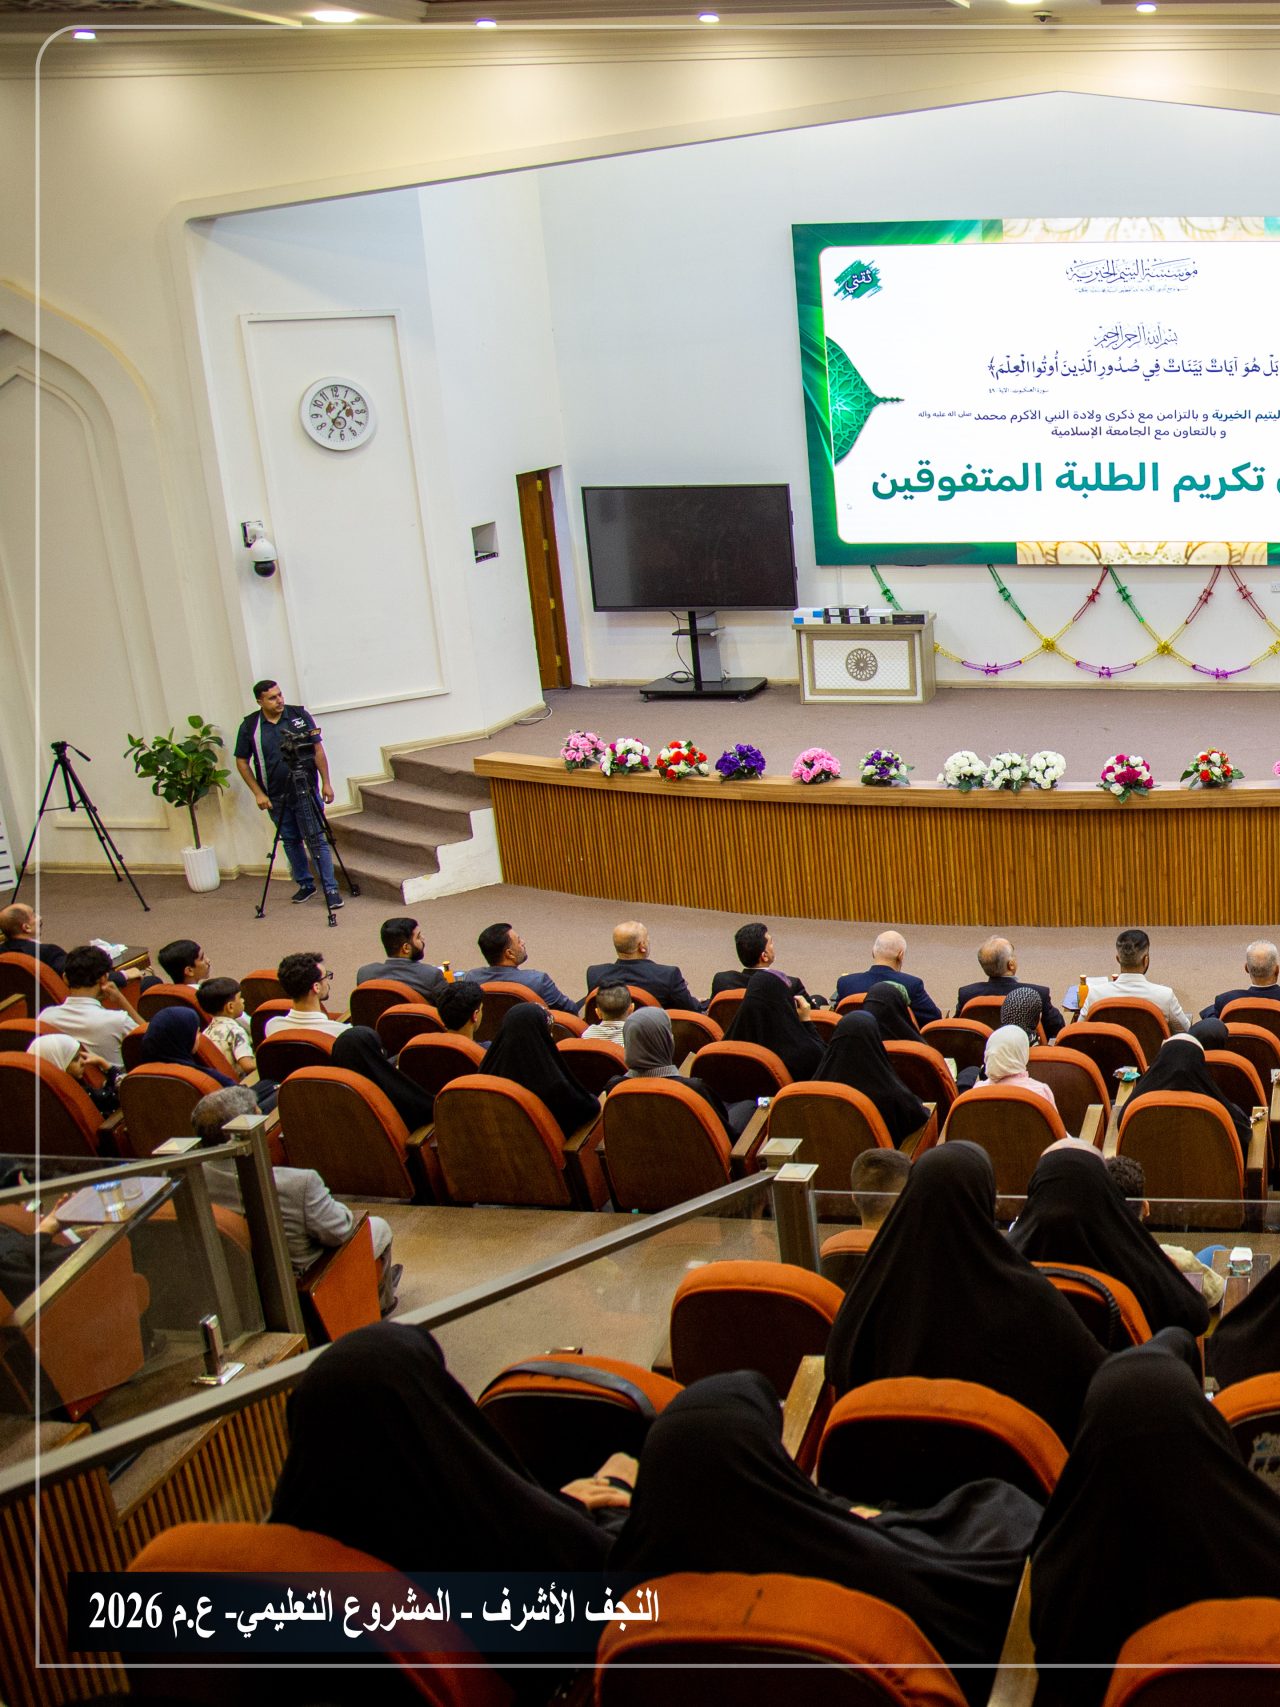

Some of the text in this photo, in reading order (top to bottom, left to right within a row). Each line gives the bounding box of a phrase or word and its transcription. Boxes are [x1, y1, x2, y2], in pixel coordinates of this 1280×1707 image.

[331, 387, 339, 398] 12
[974, 412, 1007, 421] محمد
[1044, 409, 1070, 422] النبي
[1072, 409, 1102, 422] ولادة
[1105, 409, 1135, 422] ذكرى
[1137, 412, 1154, 423] مع
[1156, 409, 1199, 422] بالتزامن
[1202, 413, 1209, 422] و
[1211, 409, 1252, 422] الخيرية
[1105, 426, 1151, 439] الجامعة
[1153, 429, 1170, 440] مع
[1173, 425, 1217, 438] بالتعاون
[1220, 429, 1228, 439] و
[872, 460, 1042, 501] المتفوقين
[1056, 462, 1158, 498] الطلبة
[1174, 462, 1265, 502] تكريم
